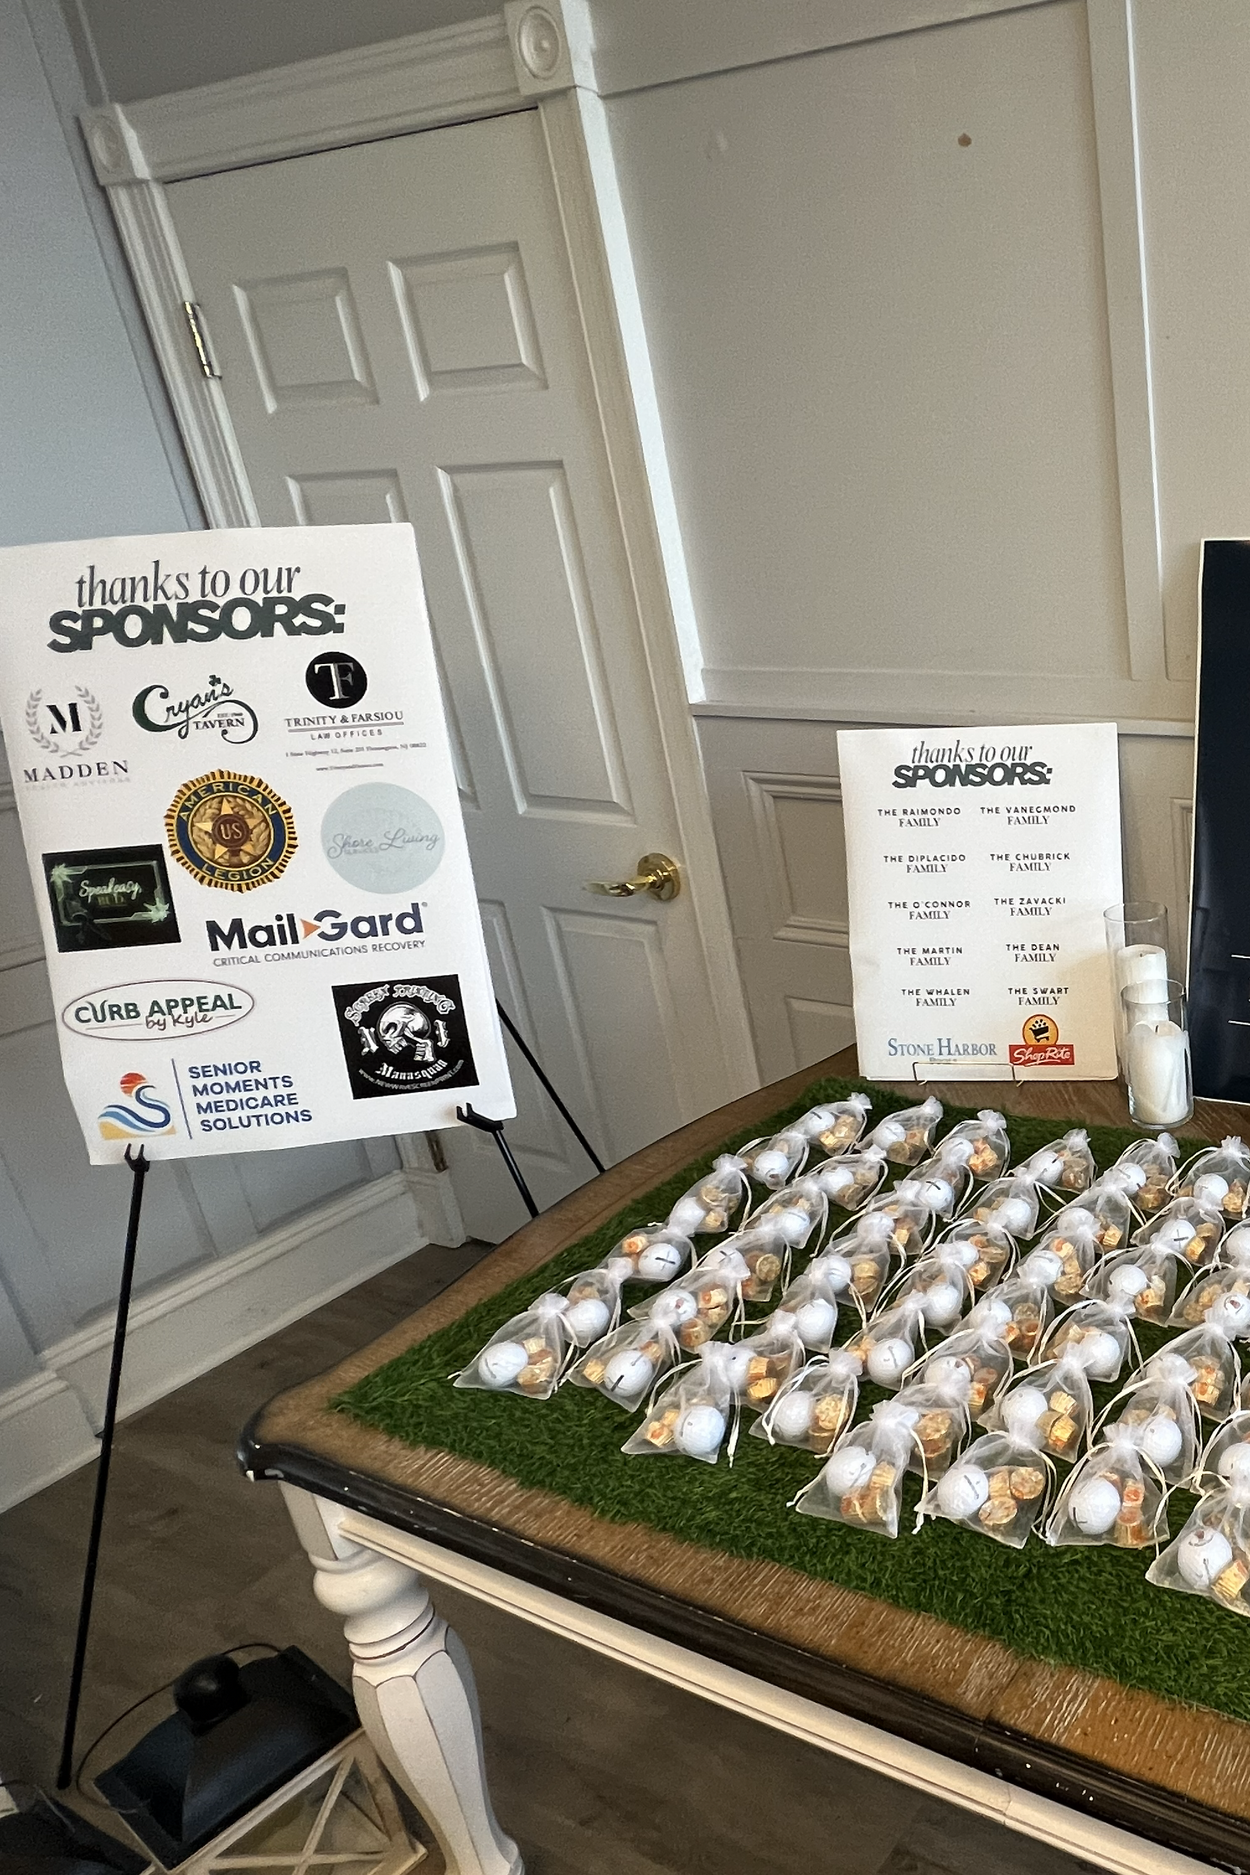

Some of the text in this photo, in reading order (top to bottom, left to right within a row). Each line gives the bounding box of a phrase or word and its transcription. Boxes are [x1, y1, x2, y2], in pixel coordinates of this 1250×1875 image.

[75, 560, 301, 608] thanks to our
[46, 593, 346, 654] SPONSORS:
[46, 702, 82, 734] M
[193, 718, 245, 730] TAVERN
[285, 711, 404, 727] TRINITY & FARSIOU
[311, 729, 383, 740] LAW OFFICES
[912, 740, 1033, 764] thanks to our
[24, 760, 128, 783] MADDEN
[892, 762, 1053, 789] SPONSORS:
[180, 783, 277, 821] AMERICAN
[980, 806, 1001, 814] THE
[903, 807, 961, 816] RAIMONDO
[899, 817, 940, 827] FAMILY
[1007, 815, 1050, 825] FAMILY
[221, 822, 242, 839] US
[327, 833, 374, 859] Shore
[379, 828, 439, 851] Living
[909, 854, 966, 862] DIPLACIDO
[1016, 853, 1070, 861] CHUBRICK
[202, 858, 274, 880] LEGION
[907, 863, 948, 873] FAMILY
[1010, 862, 1051, 871] FAMILY
[914, 900, 971, 908] O'CONNOR
[1010, 907, 1051, 916] FAMILY
[909, 910, 950, 920] FAMILY
[213, 940, 425, 967] CRITICAL COMMUNICATIONS RECOVERY
[910, 957, 951, 966] FAMILY
[1015, 953, 1056, 963] FAMILY
[927, 988, 970, 996] WHALEN
[1008, 987, 1028, 995] THE
[74, 993, 242, 1023] CURB APPEAL
[916, 997, 957, 1007] FAMILY
[1018, 997, 1060, 1005] FAMILY
[145, 1012, 213, 1031] by Kyle
[888, 1038, 997, 1057] STONE HARBOR
[1013, 1045, 1071, 1065] ShopRite
[189, 1060, 261, 1079] SENIOR
[375, 1059, 448, 1080] Manasquan
[192, 1075, 293, 1097] MOMENTS
[197, 1093, 299, 1114] MEDICARE
[201, 1109, 312, 1132] SOLUTIONS
